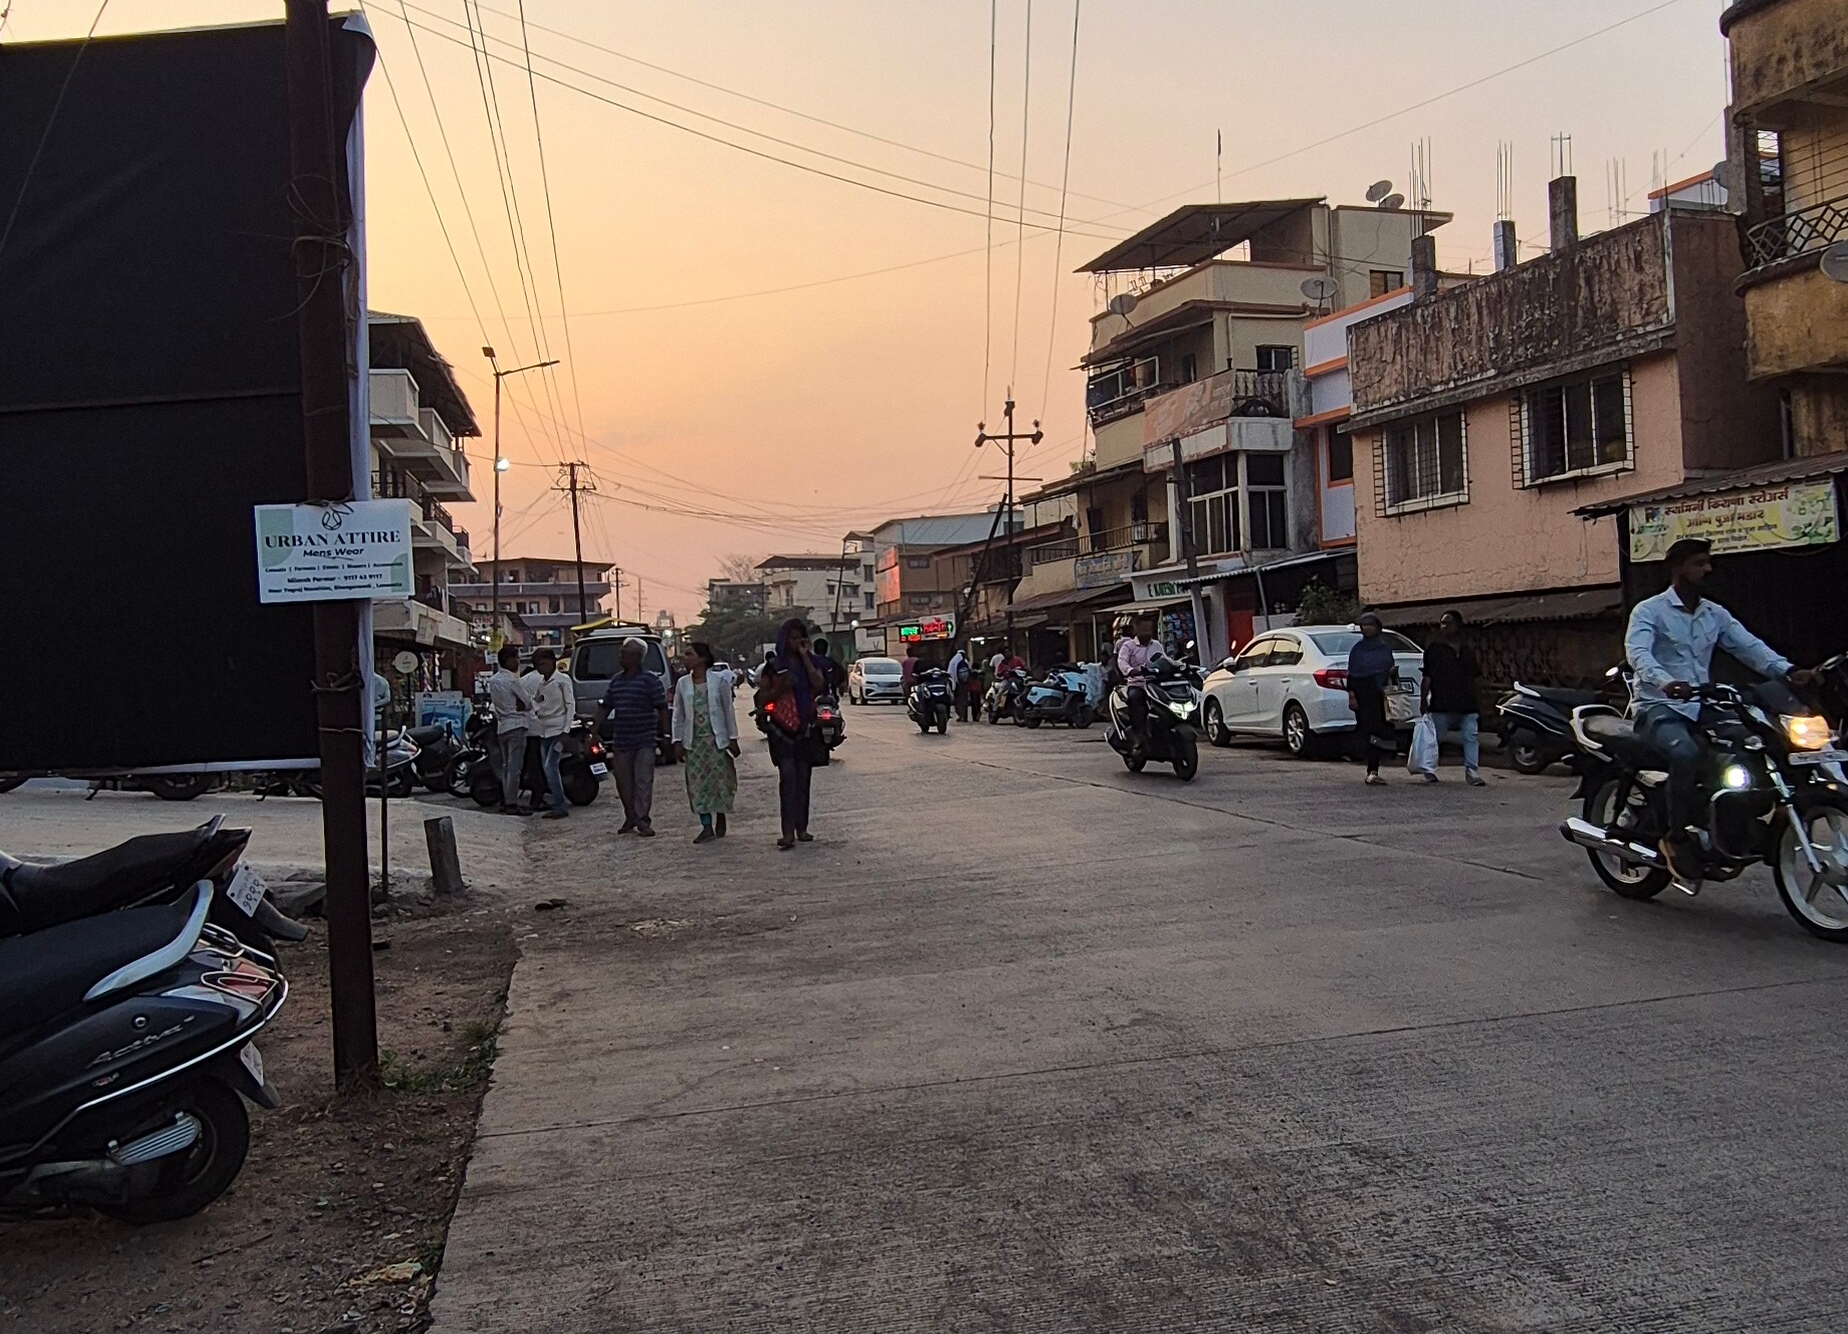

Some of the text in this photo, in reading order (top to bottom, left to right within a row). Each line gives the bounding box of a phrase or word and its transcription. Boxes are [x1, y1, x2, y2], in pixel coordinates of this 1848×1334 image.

[265, 530, 401, 548] URBAN ATTIRE
[303, 548, 364, 557] Mens Wear
